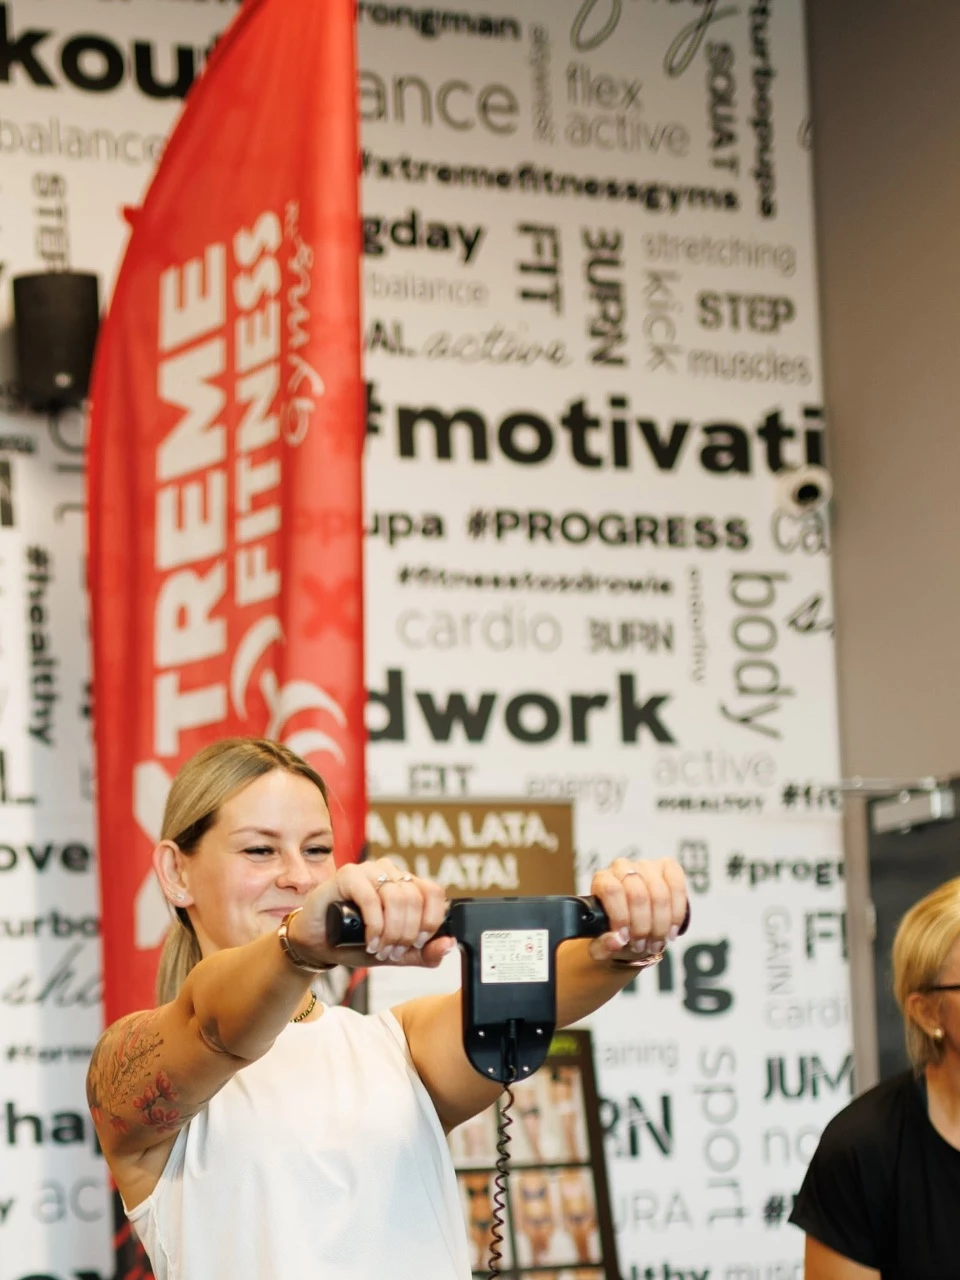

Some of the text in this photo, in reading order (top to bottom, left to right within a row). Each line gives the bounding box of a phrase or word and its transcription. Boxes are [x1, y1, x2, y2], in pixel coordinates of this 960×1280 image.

[566, 61, 643, 113] flex
[707, 42, 738, 175] SQUAT
[564, 115, 691, 157] active
[643, 231, 797, 277] stretching
[696, 289, 796, 334] STEP
[688, 348, 813, 387] muscles
[233, 209, 281, 608] FITNESS
[465, 508, 751, 551] #PROGRESS
[394, 604, 565, 653] cardio
[720, 569, 794, 741] body
[394, 811, 454, 848] NA
[692, 1046, 746, 1230] sport
